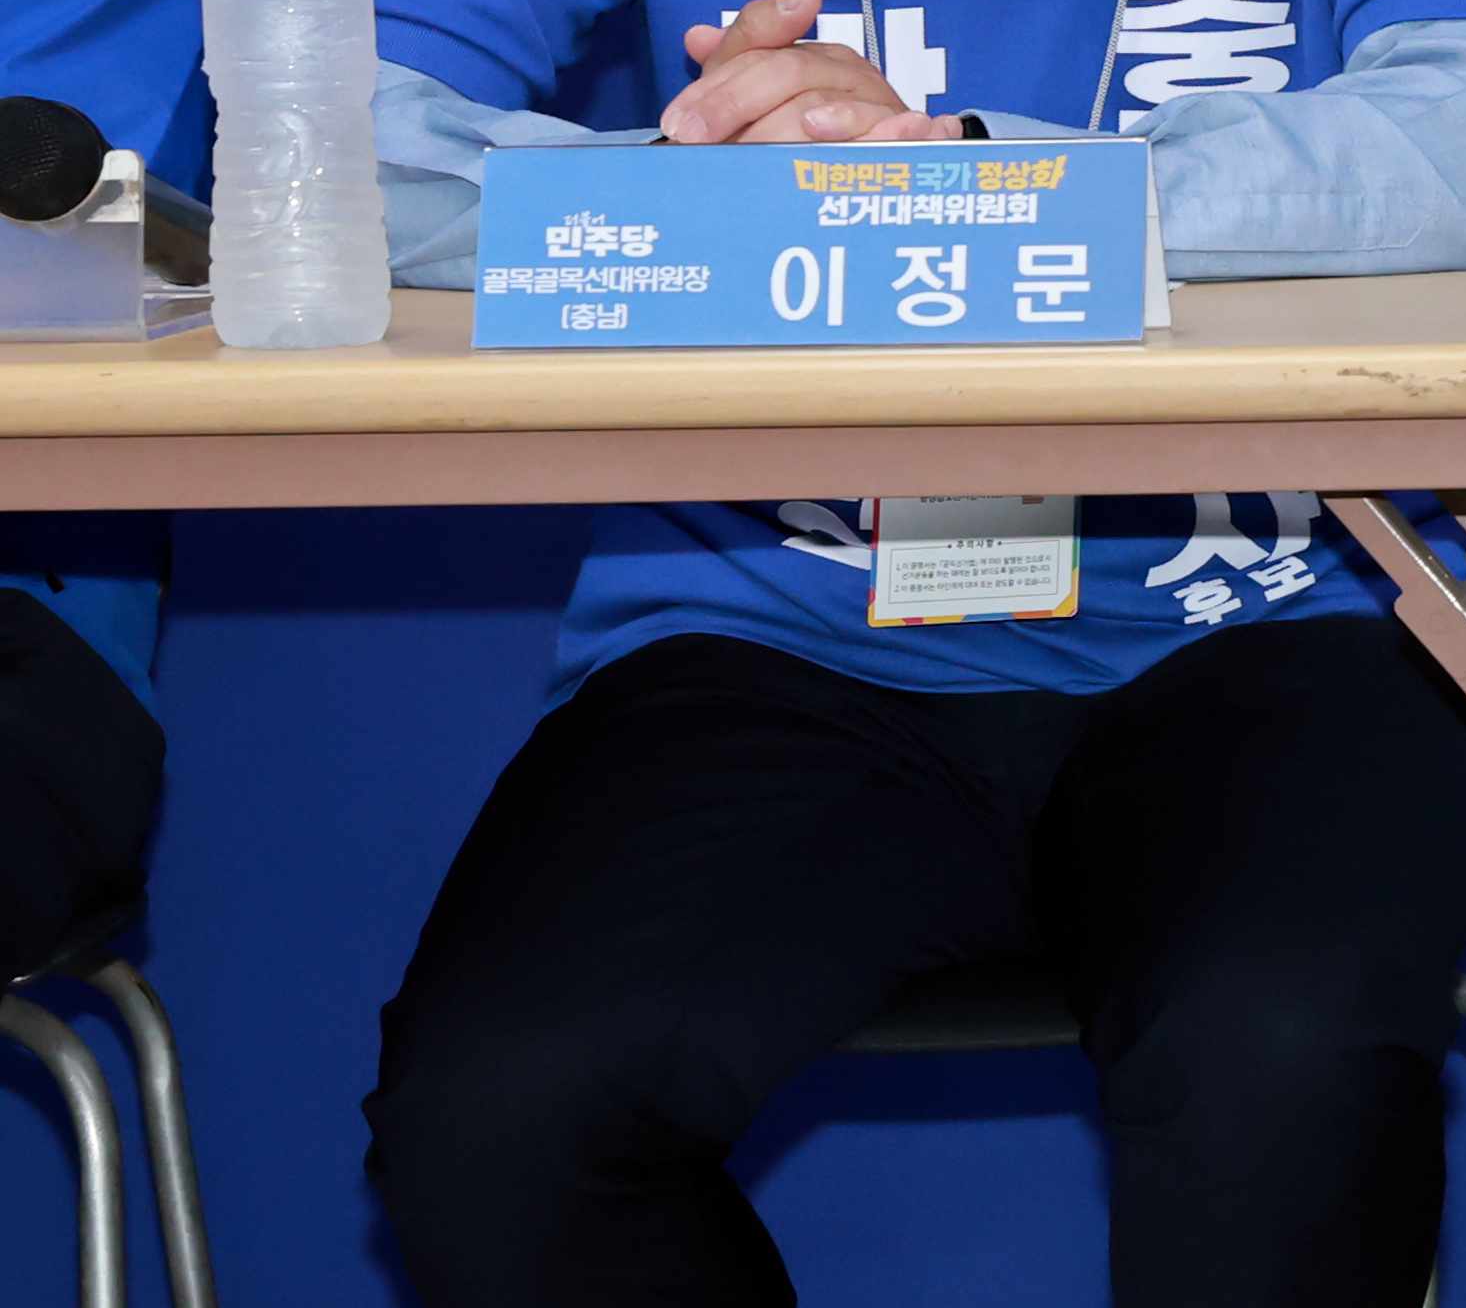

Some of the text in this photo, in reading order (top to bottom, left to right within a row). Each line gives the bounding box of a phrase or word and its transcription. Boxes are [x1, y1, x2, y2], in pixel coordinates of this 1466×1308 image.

[792, 154, 1068, 193] 대한민국 국가 정상화
[816, 192, 1037, 227] 선거대책위원회
[545, 224, 660, 258] 민주당
[482, 265, 712, 294] 골목골목선대위원장
